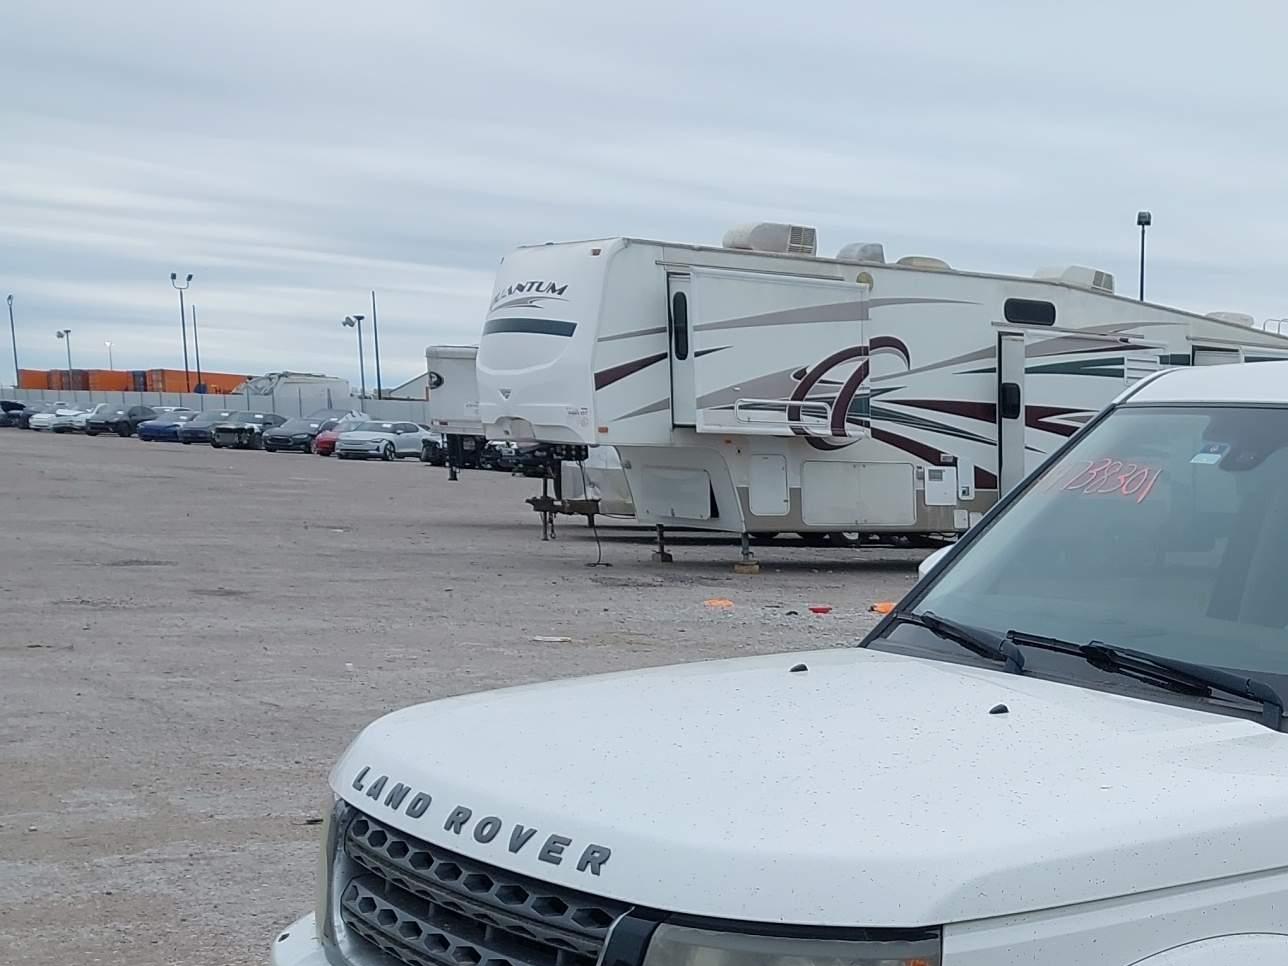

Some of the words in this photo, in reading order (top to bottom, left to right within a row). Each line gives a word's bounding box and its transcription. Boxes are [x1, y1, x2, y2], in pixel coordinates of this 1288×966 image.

[495, 280, 569, 302] ANTUM
[351, 765, 433, 820] LAND
[443, 805, 612, 877] ROVER
